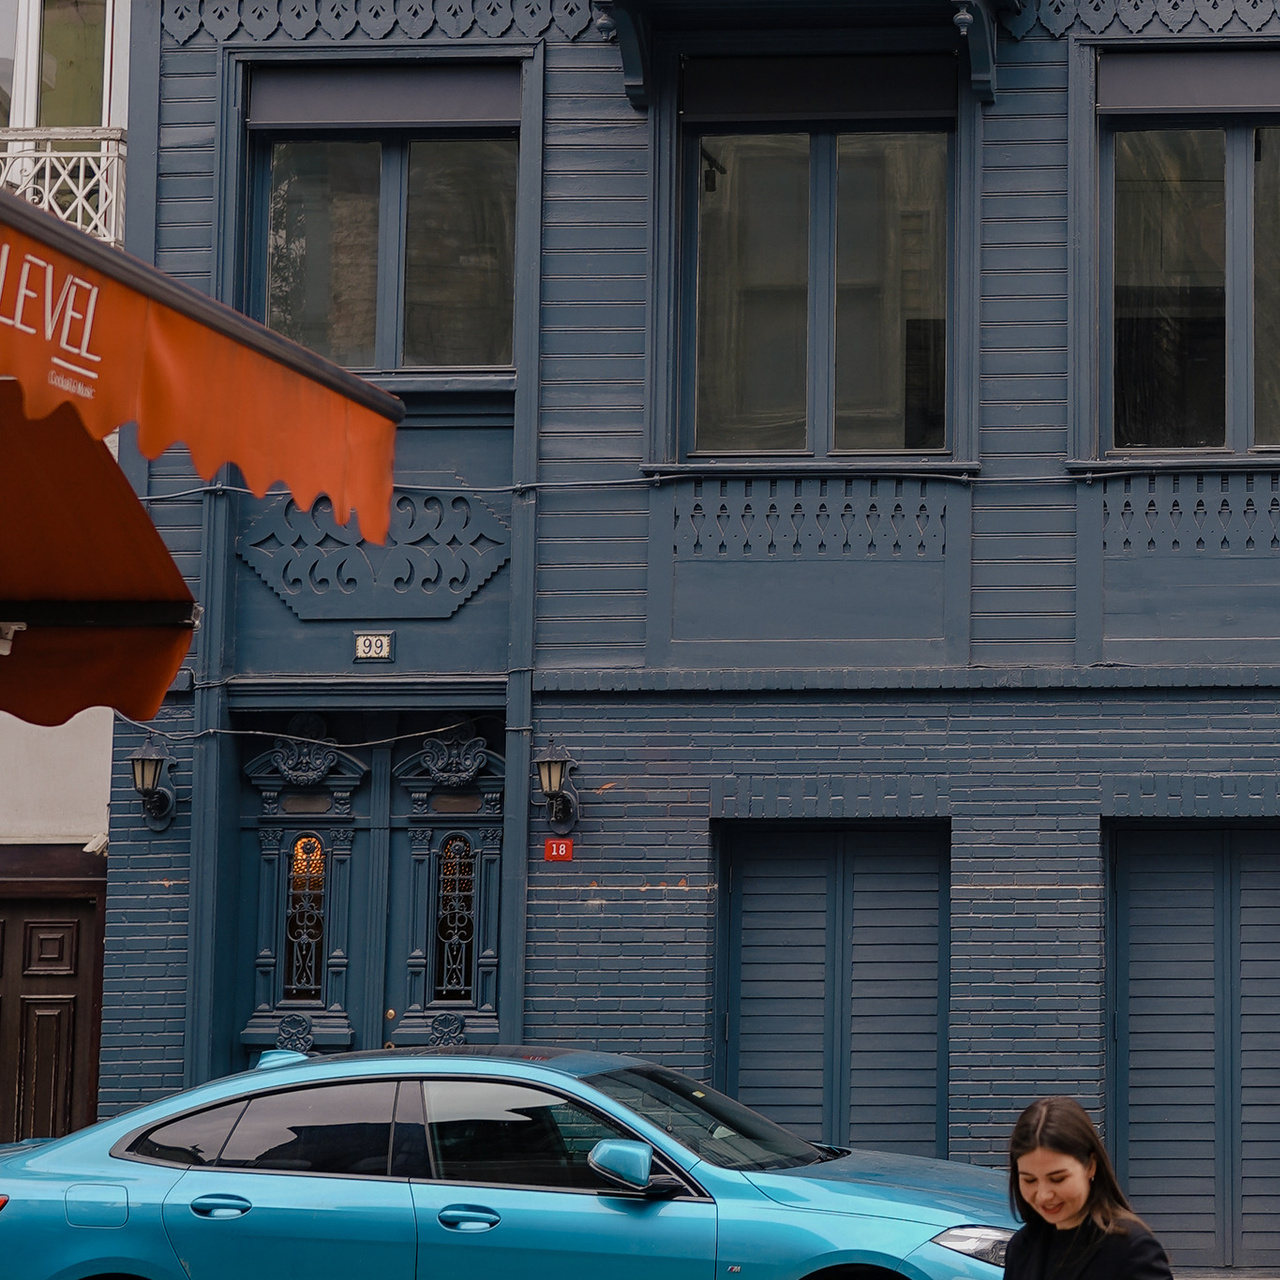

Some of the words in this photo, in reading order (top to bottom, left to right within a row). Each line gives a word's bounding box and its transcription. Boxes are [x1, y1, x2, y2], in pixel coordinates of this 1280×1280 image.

[0, 243, 101, 362] LEVEL
[363, 638, 383, 655] 99
[551, 843, 567, 856] 18
